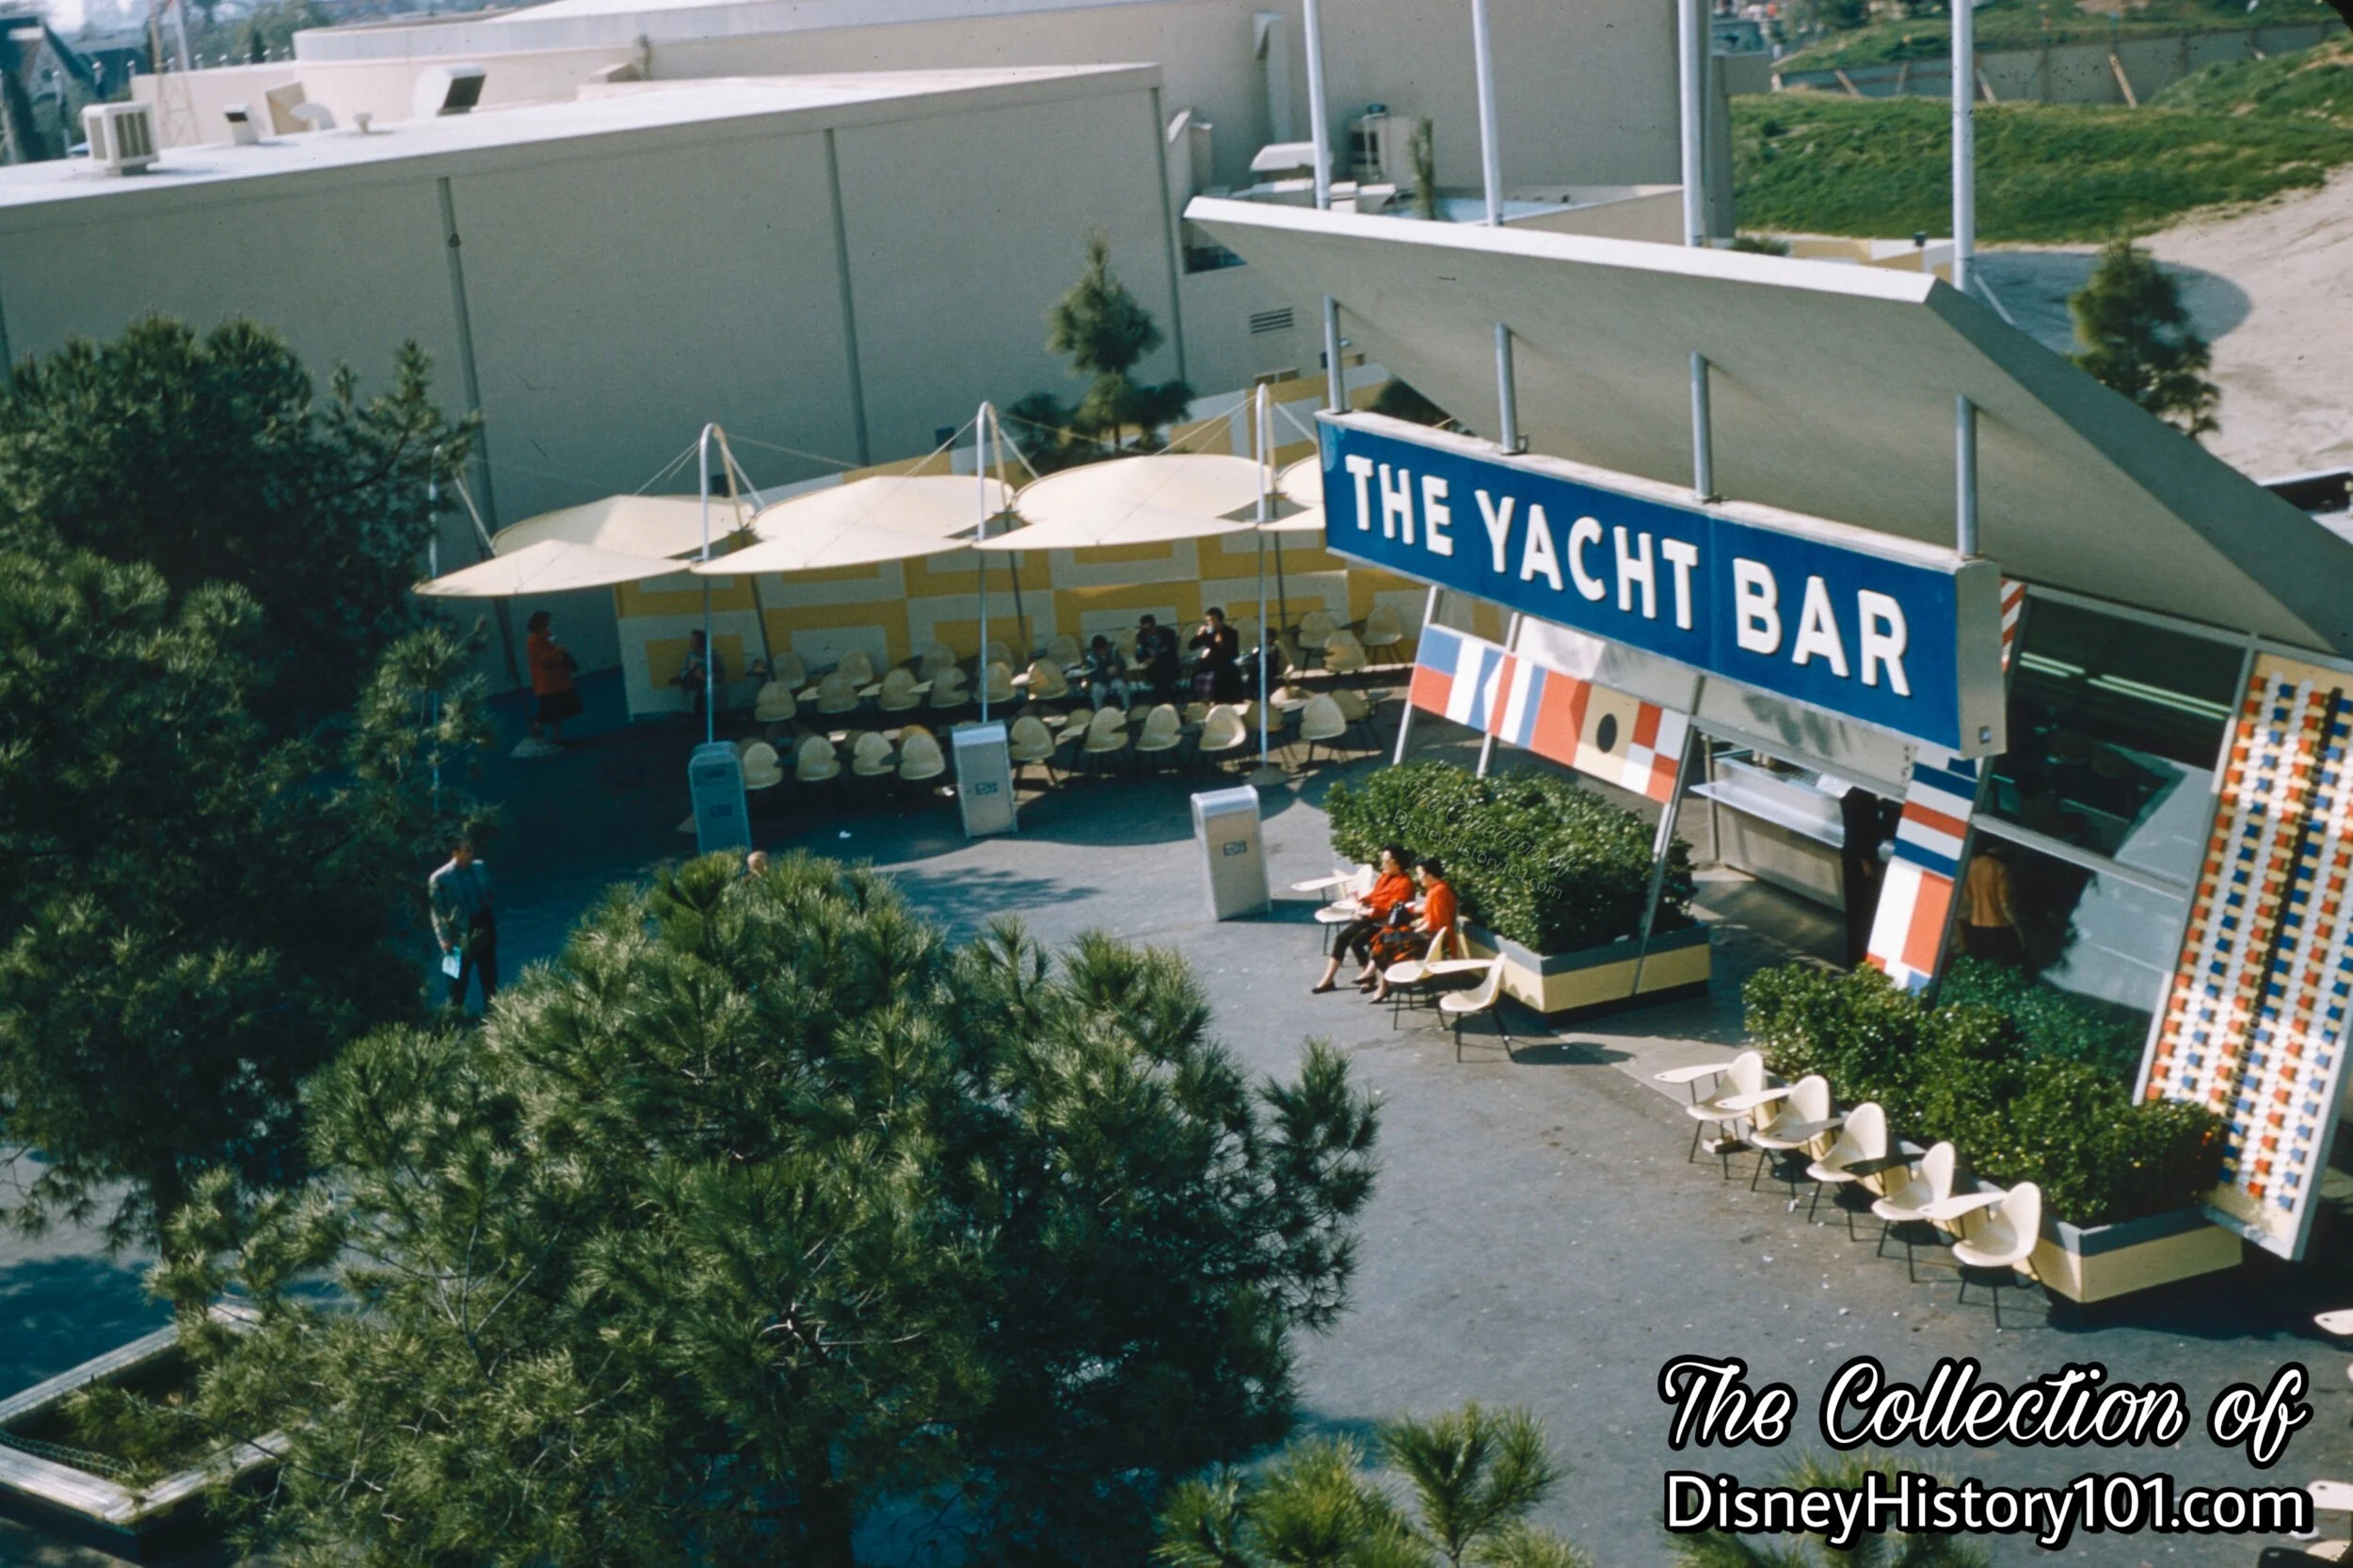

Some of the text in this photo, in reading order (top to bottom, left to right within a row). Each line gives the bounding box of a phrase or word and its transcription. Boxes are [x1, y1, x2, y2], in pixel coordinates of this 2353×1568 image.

[1346, 455, 1910, 696] THE YACHT BAR
